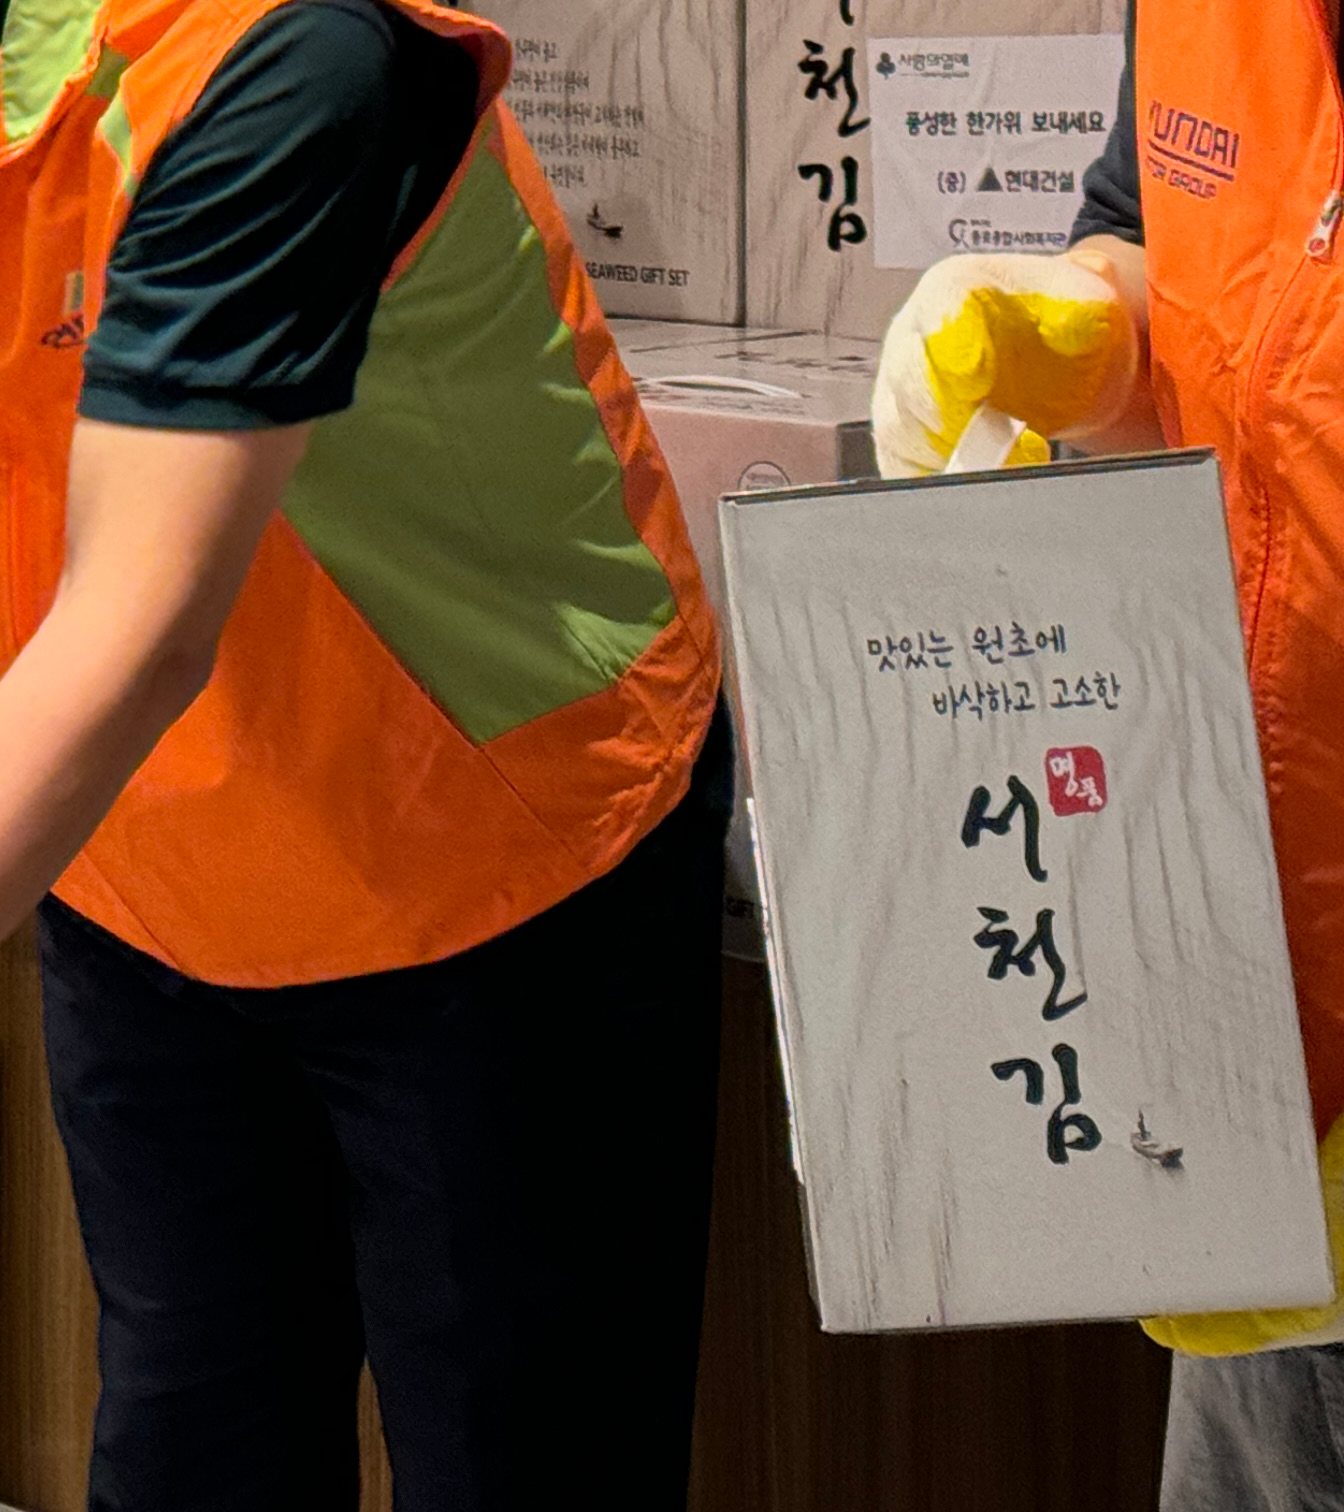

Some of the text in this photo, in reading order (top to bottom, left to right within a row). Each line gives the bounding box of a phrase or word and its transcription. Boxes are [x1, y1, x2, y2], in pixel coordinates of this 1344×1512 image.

[906, 110, 1106, 136] 풍성한 한가위 보내세요
[1005, 170, 1074, 193] 현대건설
[585, 262, 690, 286] SEAWEED GIFT SET
[867, 621, 1066, 672] 맛있는 원초에
[932, 671, 1121, 721] 바삭하고 고소한
[1048, 750, 1104, 808] 명품
[960, 774, 1102, 1165] 서천김
